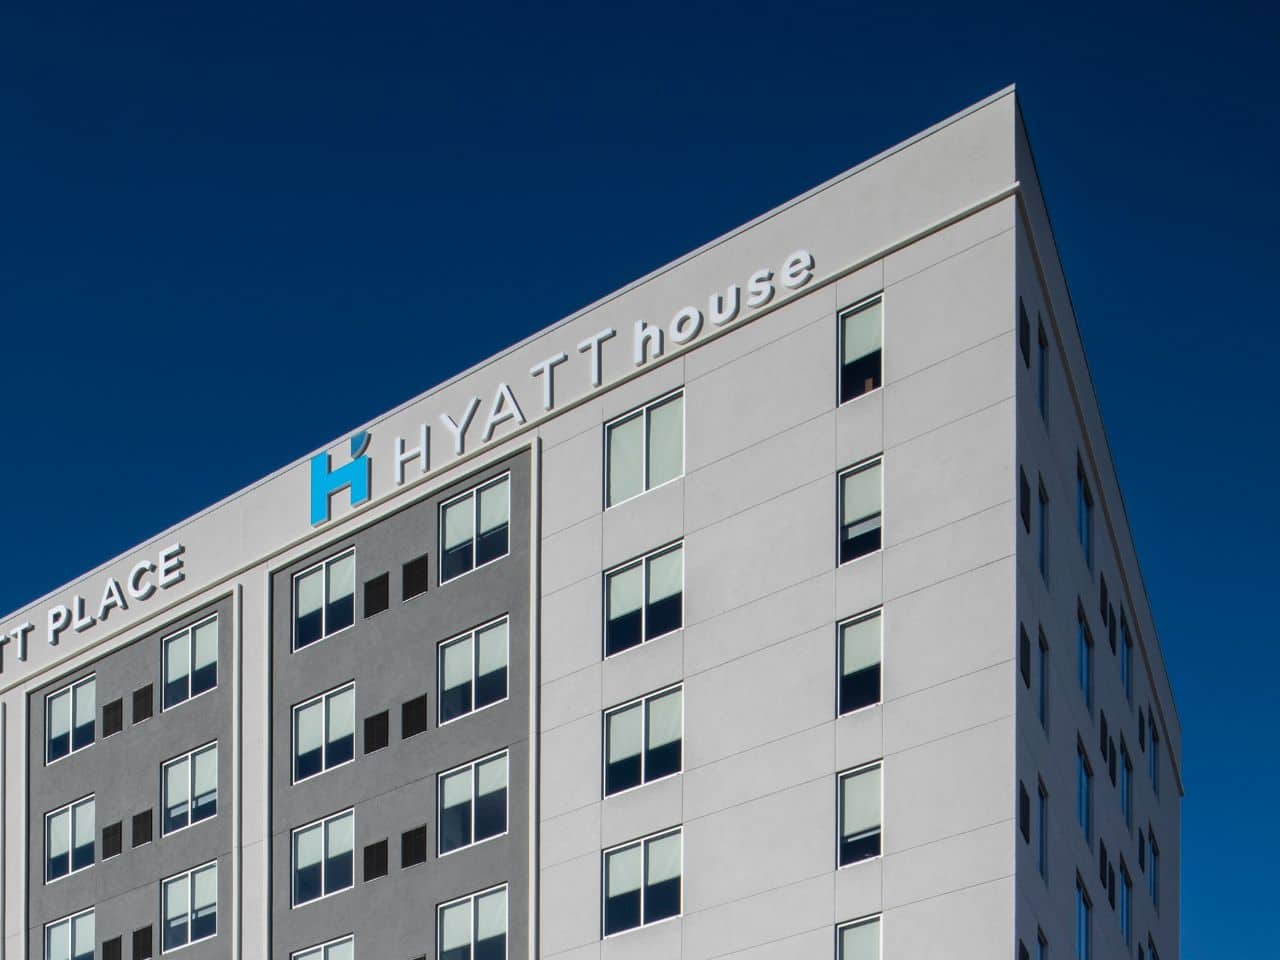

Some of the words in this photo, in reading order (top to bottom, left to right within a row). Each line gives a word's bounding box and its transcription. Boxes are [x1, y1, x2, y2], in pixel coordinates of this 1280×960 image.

[394, 327, 615, 484] HYATT
[633, 250, 814, 366] house
[48, 543, 185, 646] PLACE
